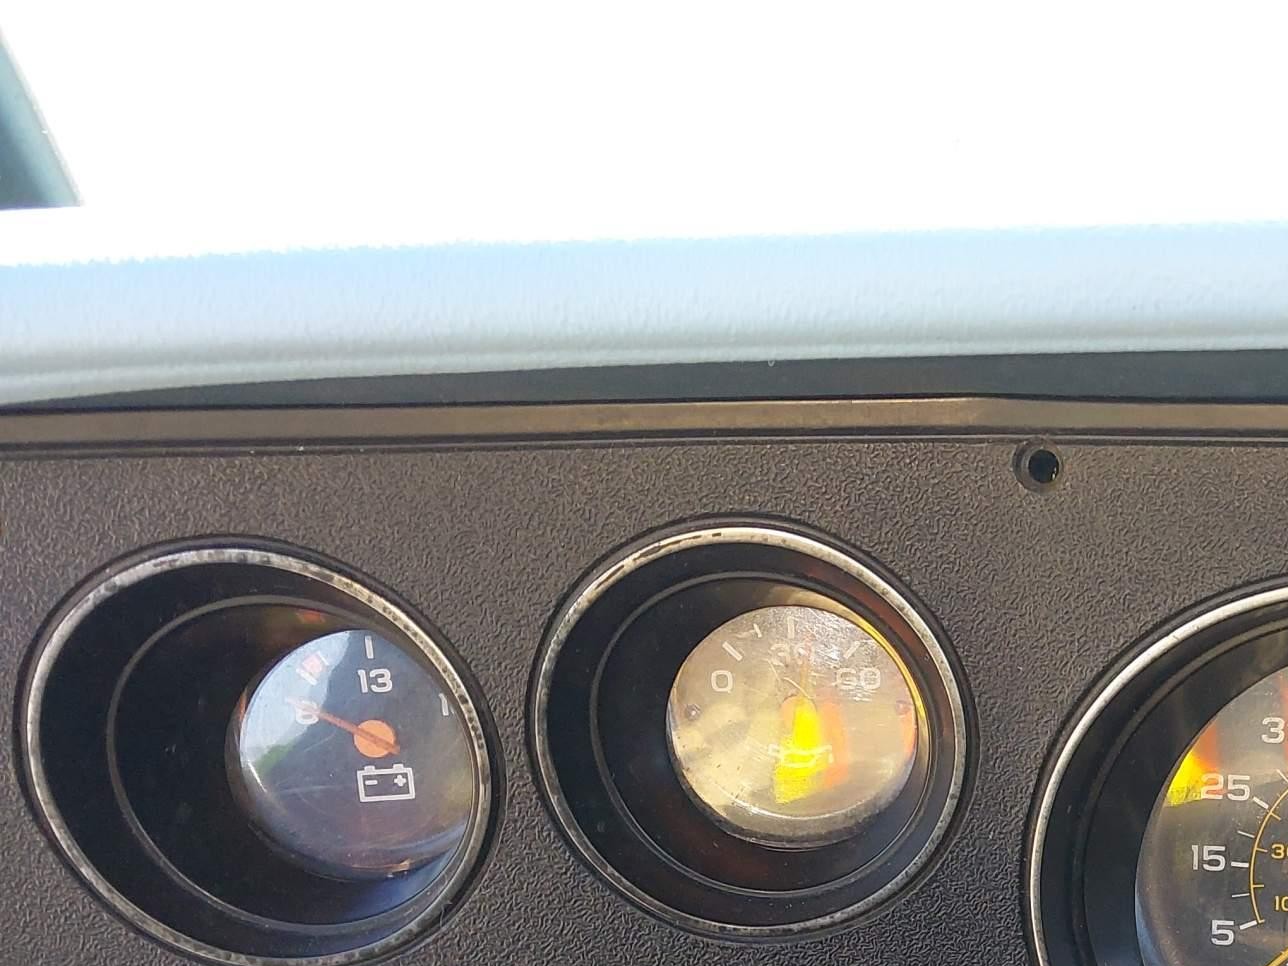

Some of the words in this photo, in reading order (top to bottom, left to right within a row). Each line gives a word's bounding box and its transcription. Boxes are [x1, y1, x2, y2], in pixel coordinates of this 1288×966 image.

[357, 668, 393, 693] 13
[1200, 773, 1251, 801] 25
[1191, 845, 1226, 871] 15
[1210, 919, 1235, 946] 5
